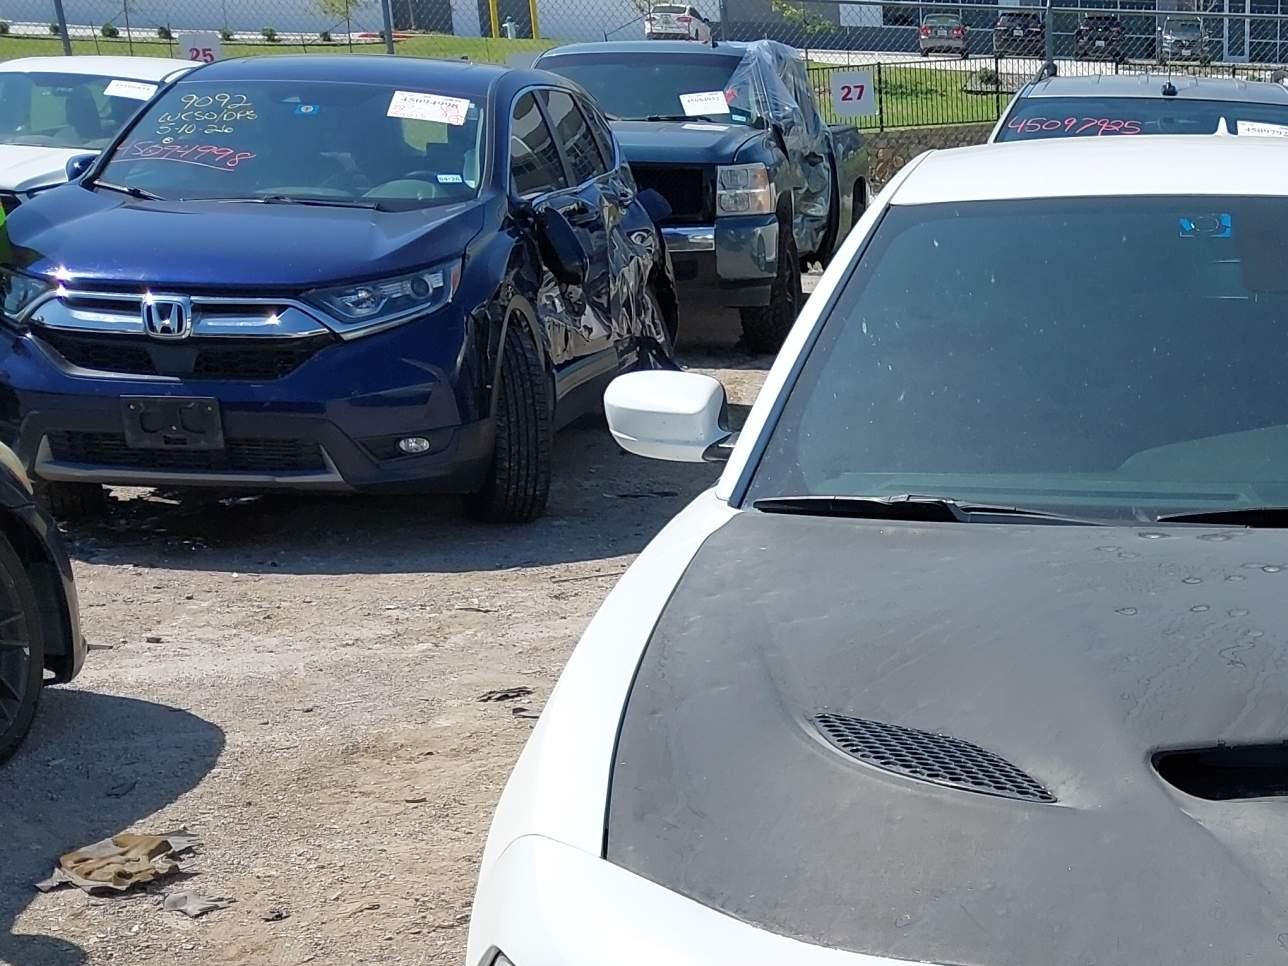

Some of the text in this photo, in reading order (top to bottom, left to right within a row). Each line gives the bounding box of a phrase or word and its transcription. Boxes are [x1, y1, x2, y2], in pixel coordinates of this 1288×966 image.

[189, 47, 215, 63] 25
[840, 84, 865, 101] 27
[180, 93, 252, 109] 9092
